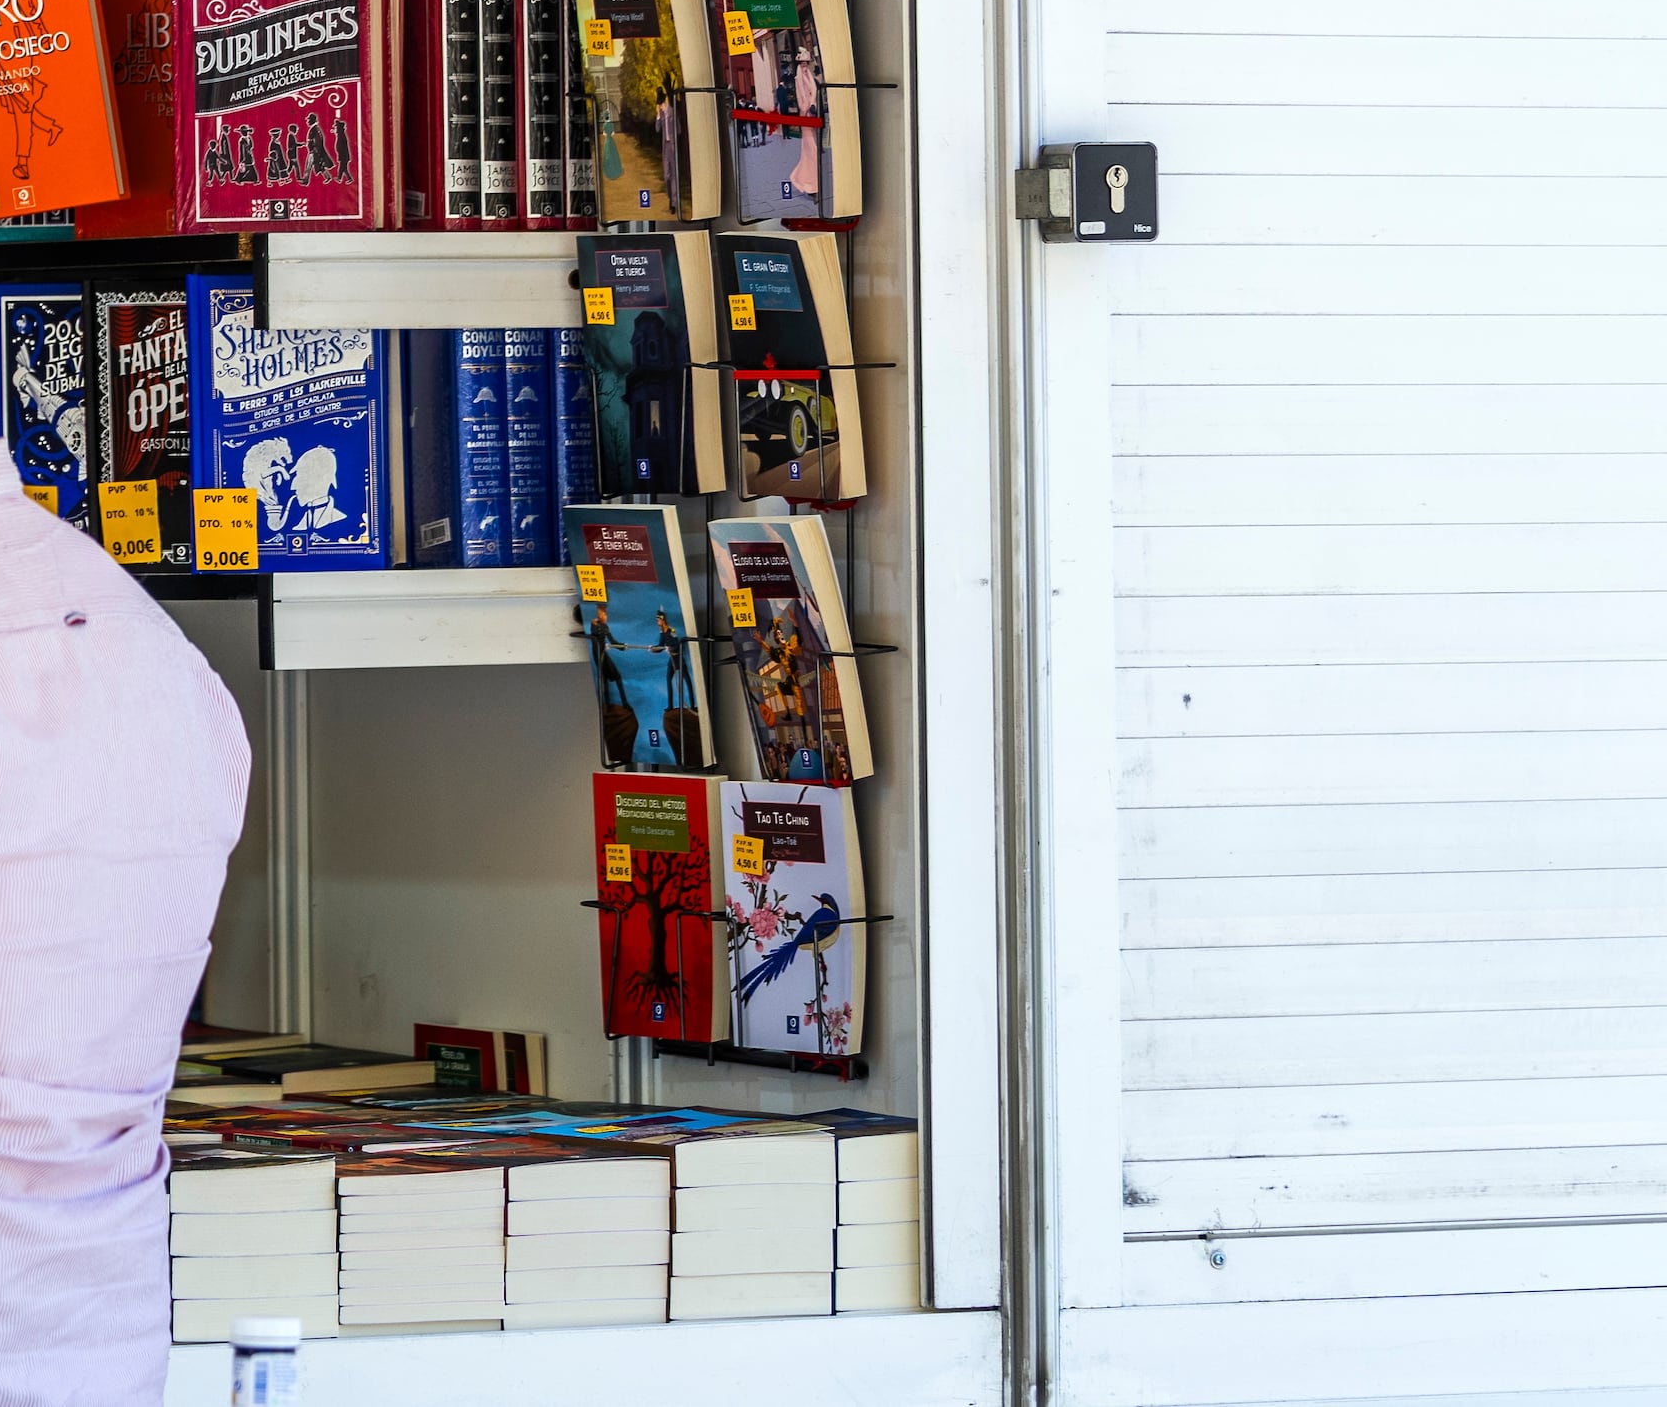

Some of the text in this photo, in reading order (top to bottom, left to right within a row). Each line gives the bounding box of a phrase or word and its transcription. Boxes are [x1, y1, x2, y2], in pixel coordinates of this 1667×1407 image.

[196, 4, 359, 75] DUBLINESES
[248, 63, 304, 86] RETRATO DEL
[230, 67, 326, 102] ARTISTA ADOLESCENTE
[611, 255, 648, 266] OTRA VUELTA
[170, 309, 184, 330] EL
[591, 311, 610, 321] 4,50 €
[505, 330, 544, 344] CONAN
[463, 345, 503, 358] DOYLE
[505, 345, 545, 358] DOYLE
[241, 336, 344, 389] HOLMES
[45, 362, 66, 381] DE
[165, 362, 187, 378] DE LA
[108, 484, 148, 494] PVP 10€
[204, 495, 248, 503] PVP 10€
[107, 508, 154, 519] DTO. 10 %
[200, 520, 222, 528] DTO.
[113, 539, 155, 556] 9,00€
[203, 551, 249, 568] 9,00€
[755, 811, 809, 826] TAO TE CHING
[737, 859, 757, 869] 4,50 €
[609, 867, 629, 876] 4,50 €
